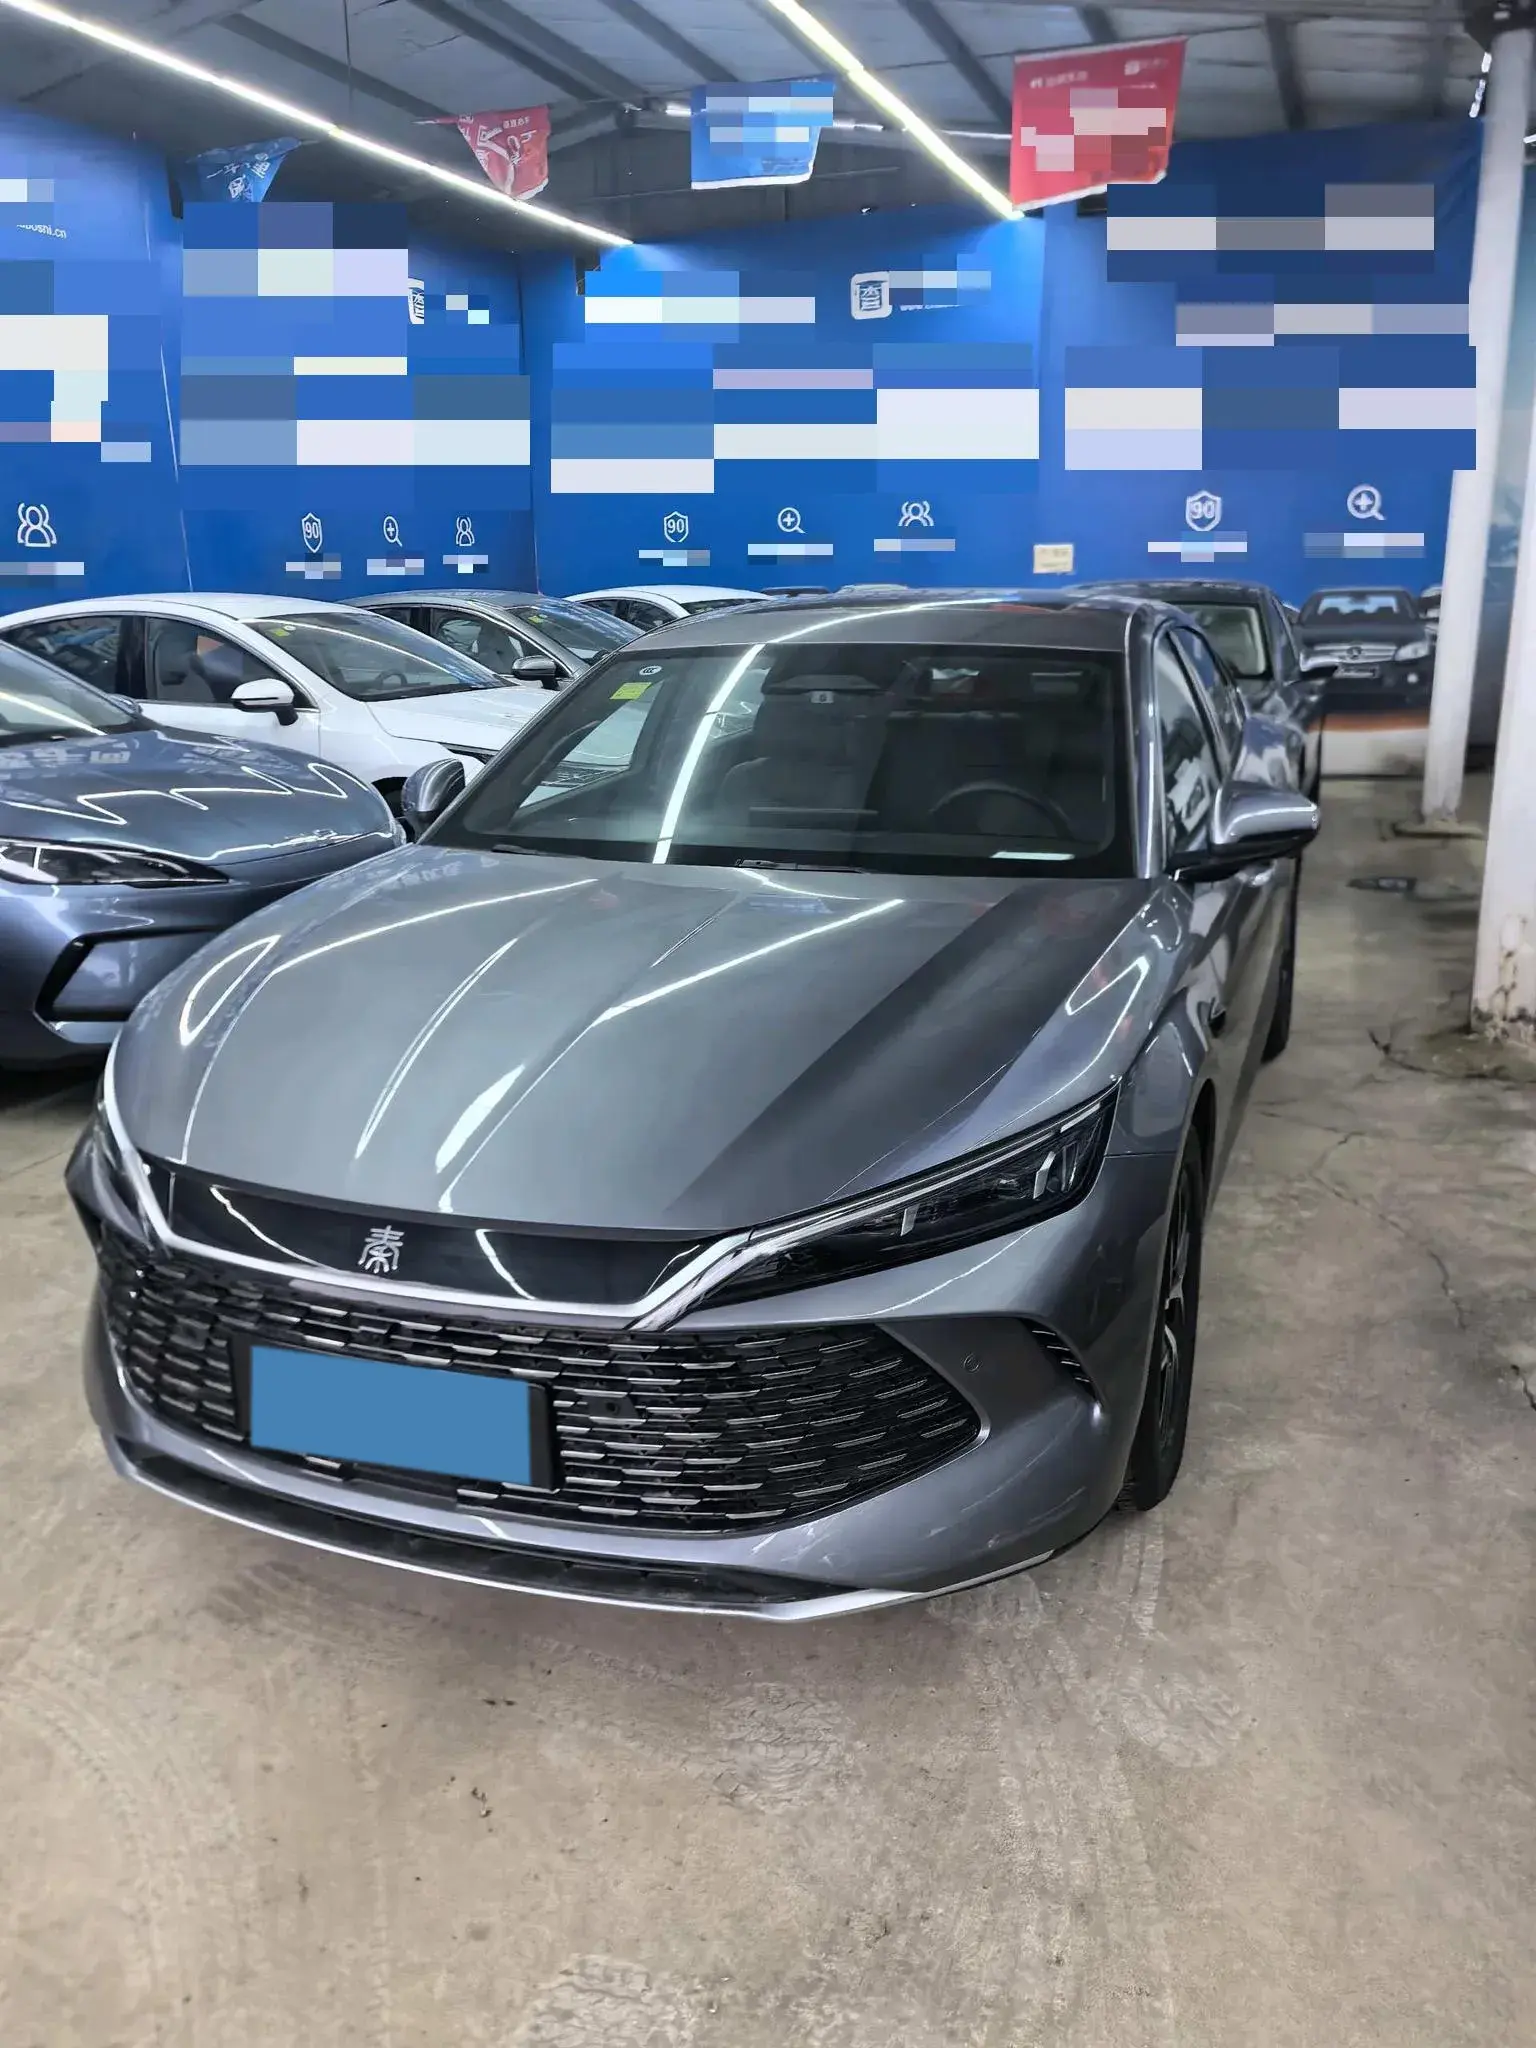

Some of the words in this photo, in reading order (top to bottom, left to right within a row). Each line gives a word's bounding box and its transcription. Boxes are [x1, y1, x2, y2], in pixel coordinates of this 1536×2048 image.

[1190, 500, 1215, 519] 90
[304, 521, 320, 539] 90
[667, 518, 685, 534] 90
[357, 1225, 405, 1274] 秦
